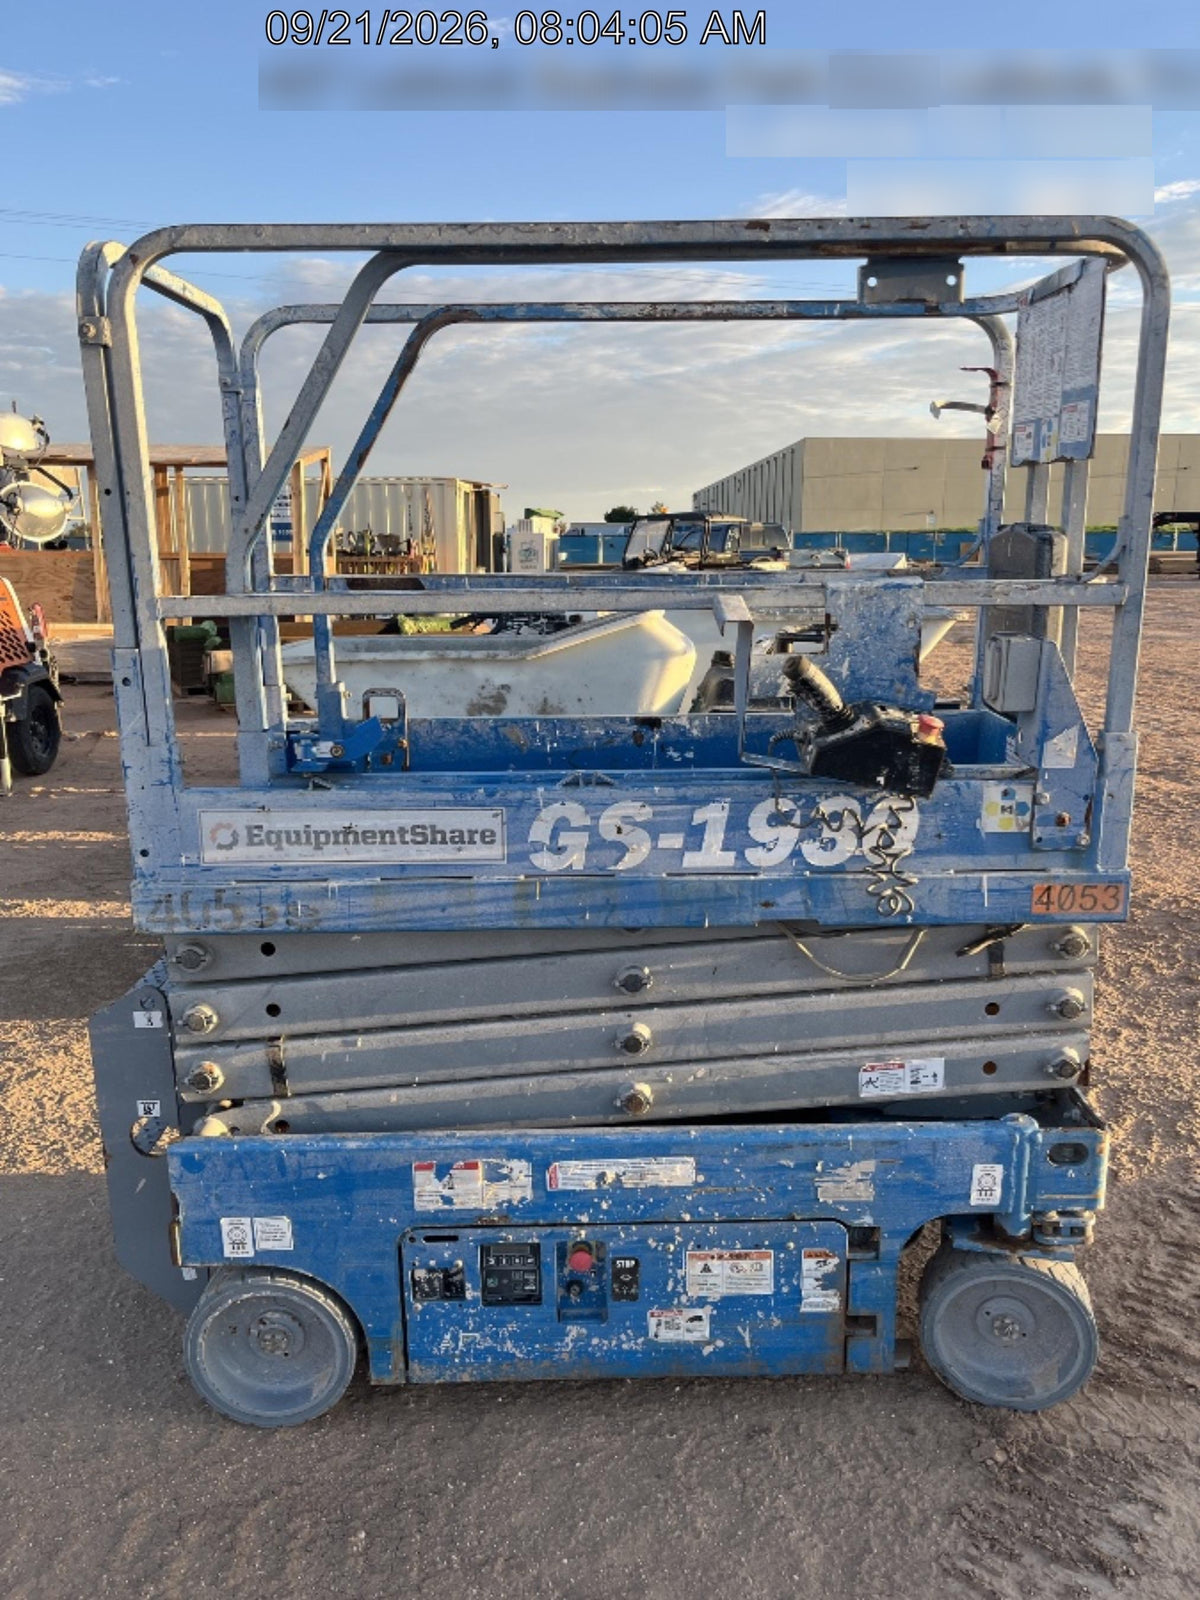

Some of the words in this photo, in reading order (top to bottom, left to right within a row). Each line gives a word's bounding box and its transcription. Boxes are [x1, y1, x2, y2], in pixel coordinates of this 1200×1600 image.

[245, 824, 496, 850] EquipmentShare
[528, 797, 920, 871] GS-1930
[1034, 885, 1120, 911] 4053
